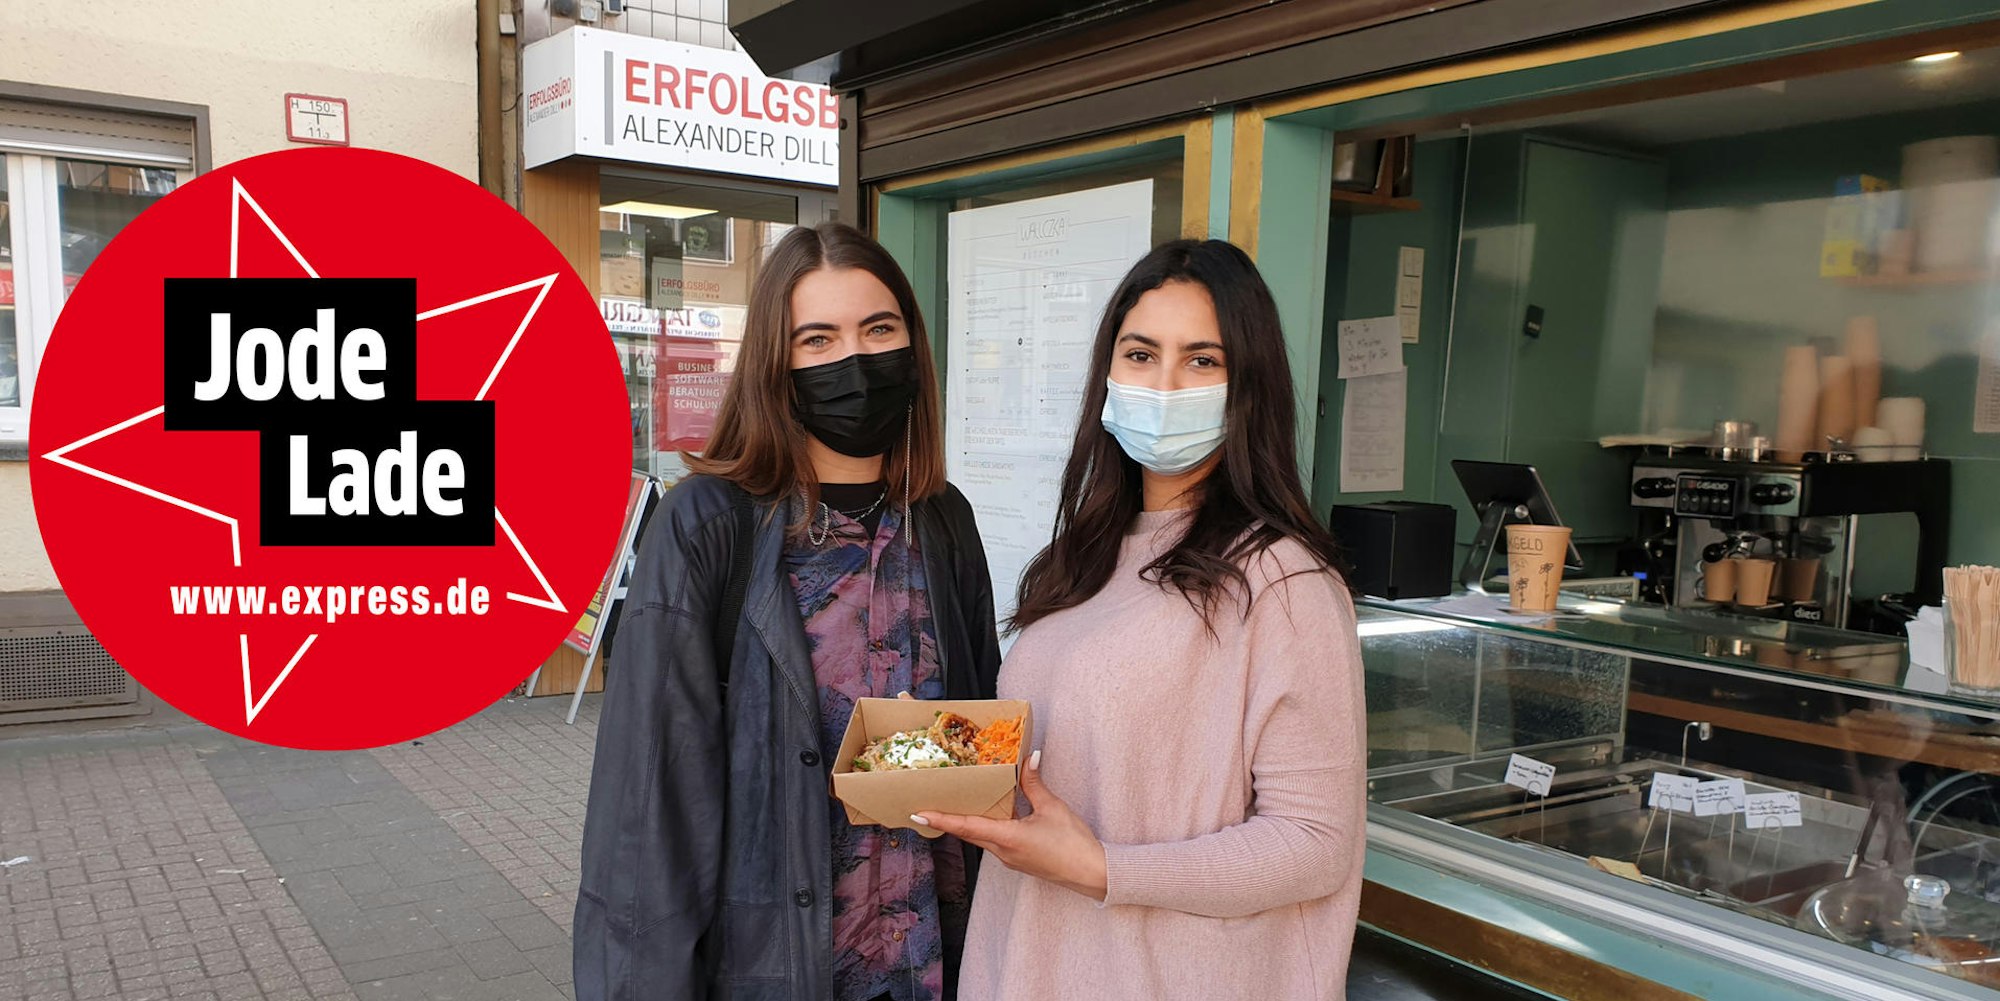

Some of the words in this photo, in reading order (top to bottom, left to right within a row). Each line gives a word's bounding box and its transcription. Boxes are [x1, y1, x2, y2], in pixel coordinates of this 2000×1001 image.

[291, 99, 299, 109] H
[309, 100, 331, 113] 150
[622, 114, 775, 158] ALEXANDER
[784, 135, 839, 167] DILL
[660, 277, 720, 293] ERFOLGSBÜRO
[669, 386, 720, 398] BERATUNG
[1794, 607, 1821, 620] dieci
